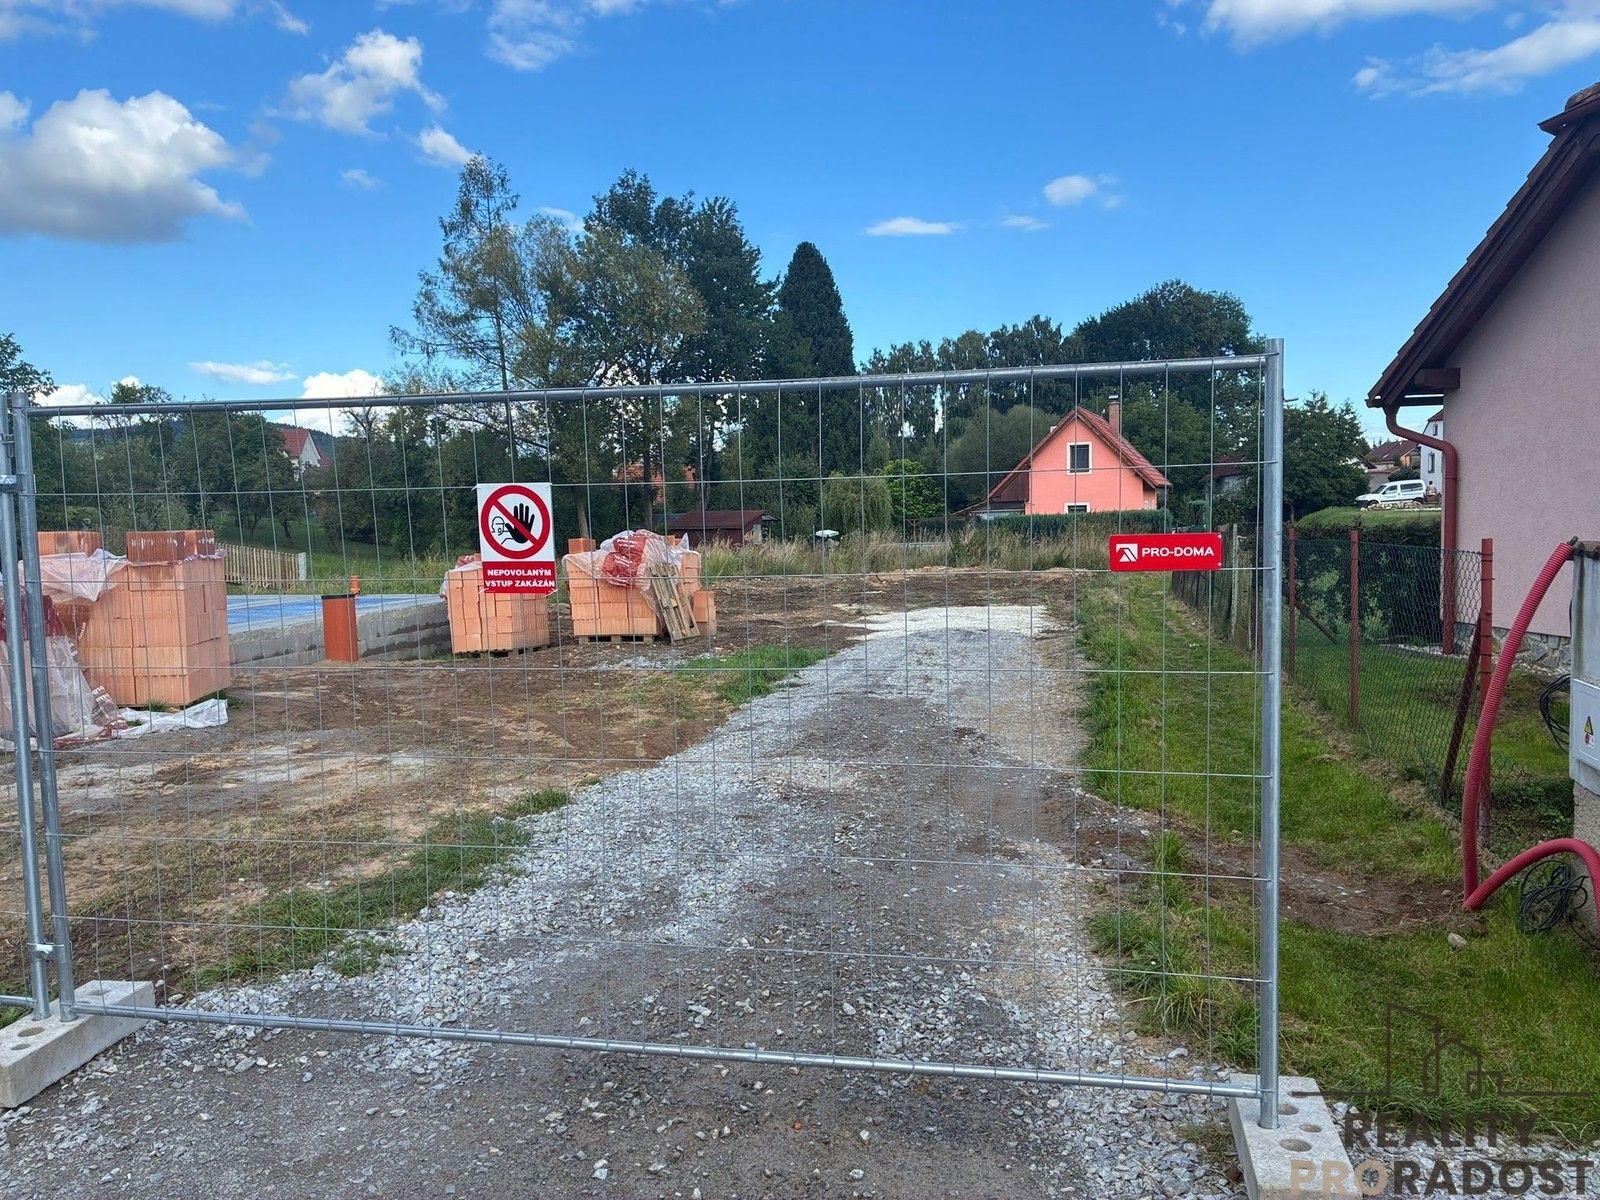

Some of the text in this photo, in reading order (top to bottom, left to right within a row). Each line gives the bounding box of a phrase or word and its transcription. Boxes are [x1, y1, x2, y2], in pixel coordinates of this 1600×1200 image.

[1142, 547, 1214, 557] PRO-DOMA
[487, 568, 552, 577] NEPOVOLANÝM
[515, 579, 555, 587] ZAKÁZÁN
